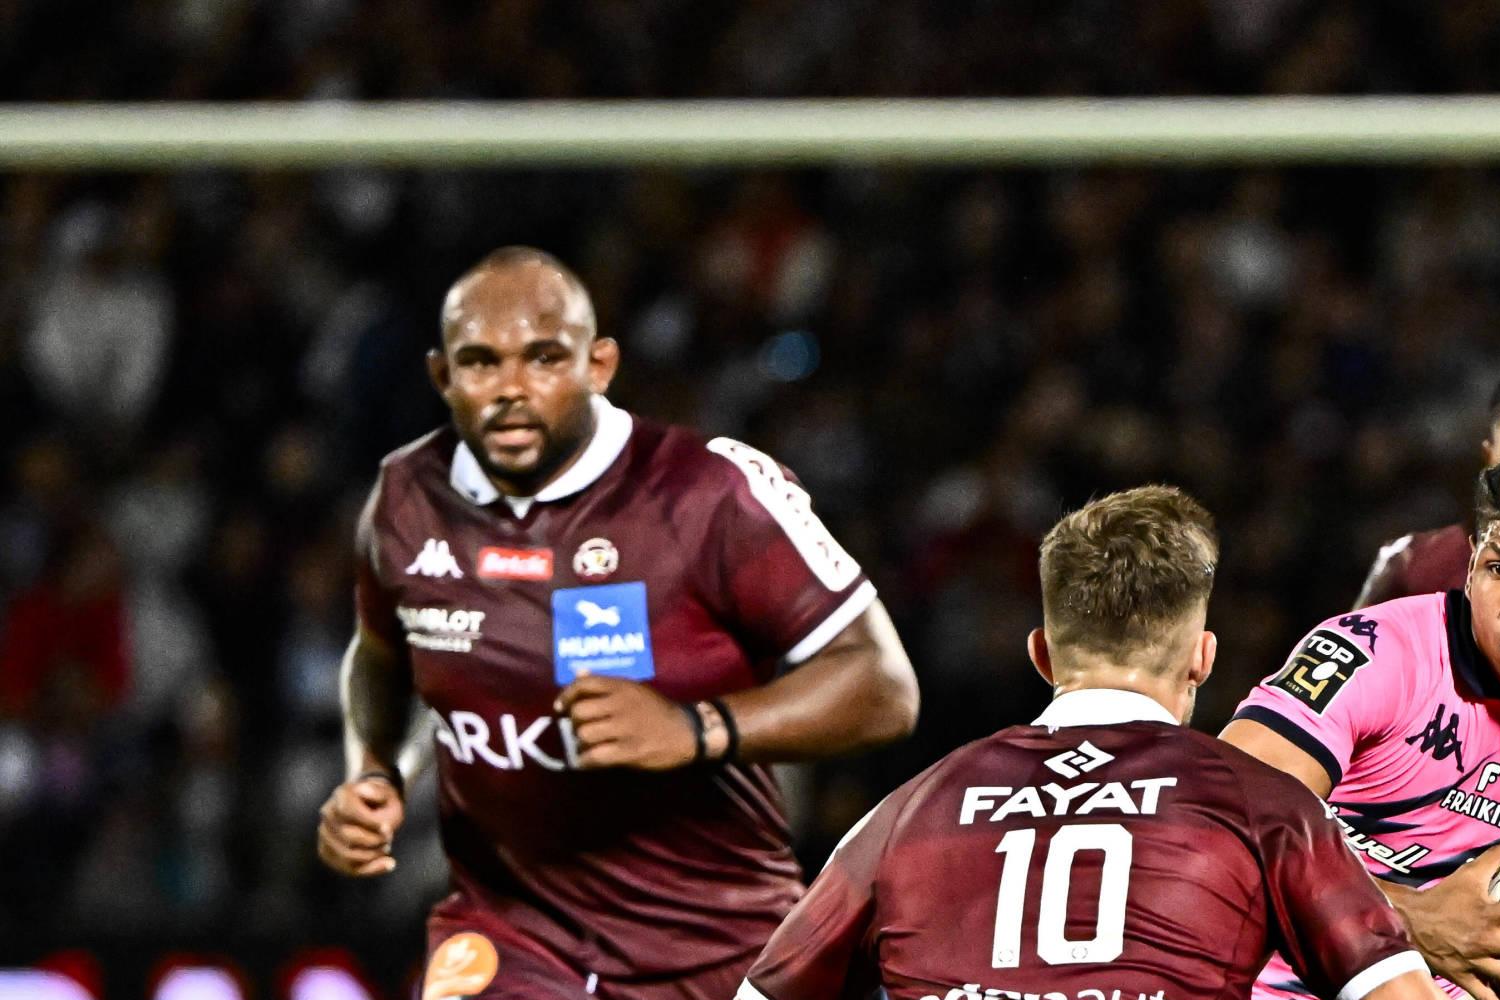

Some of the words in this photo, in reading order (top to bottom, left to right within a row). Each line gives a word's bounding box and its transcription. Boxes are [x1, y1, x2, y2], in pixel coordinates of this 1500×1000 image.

[1307, 635, 1355, 665] TOP
[959, 777, 1178, 825] FAYAT
[990, 824, 1133, 969] 10
